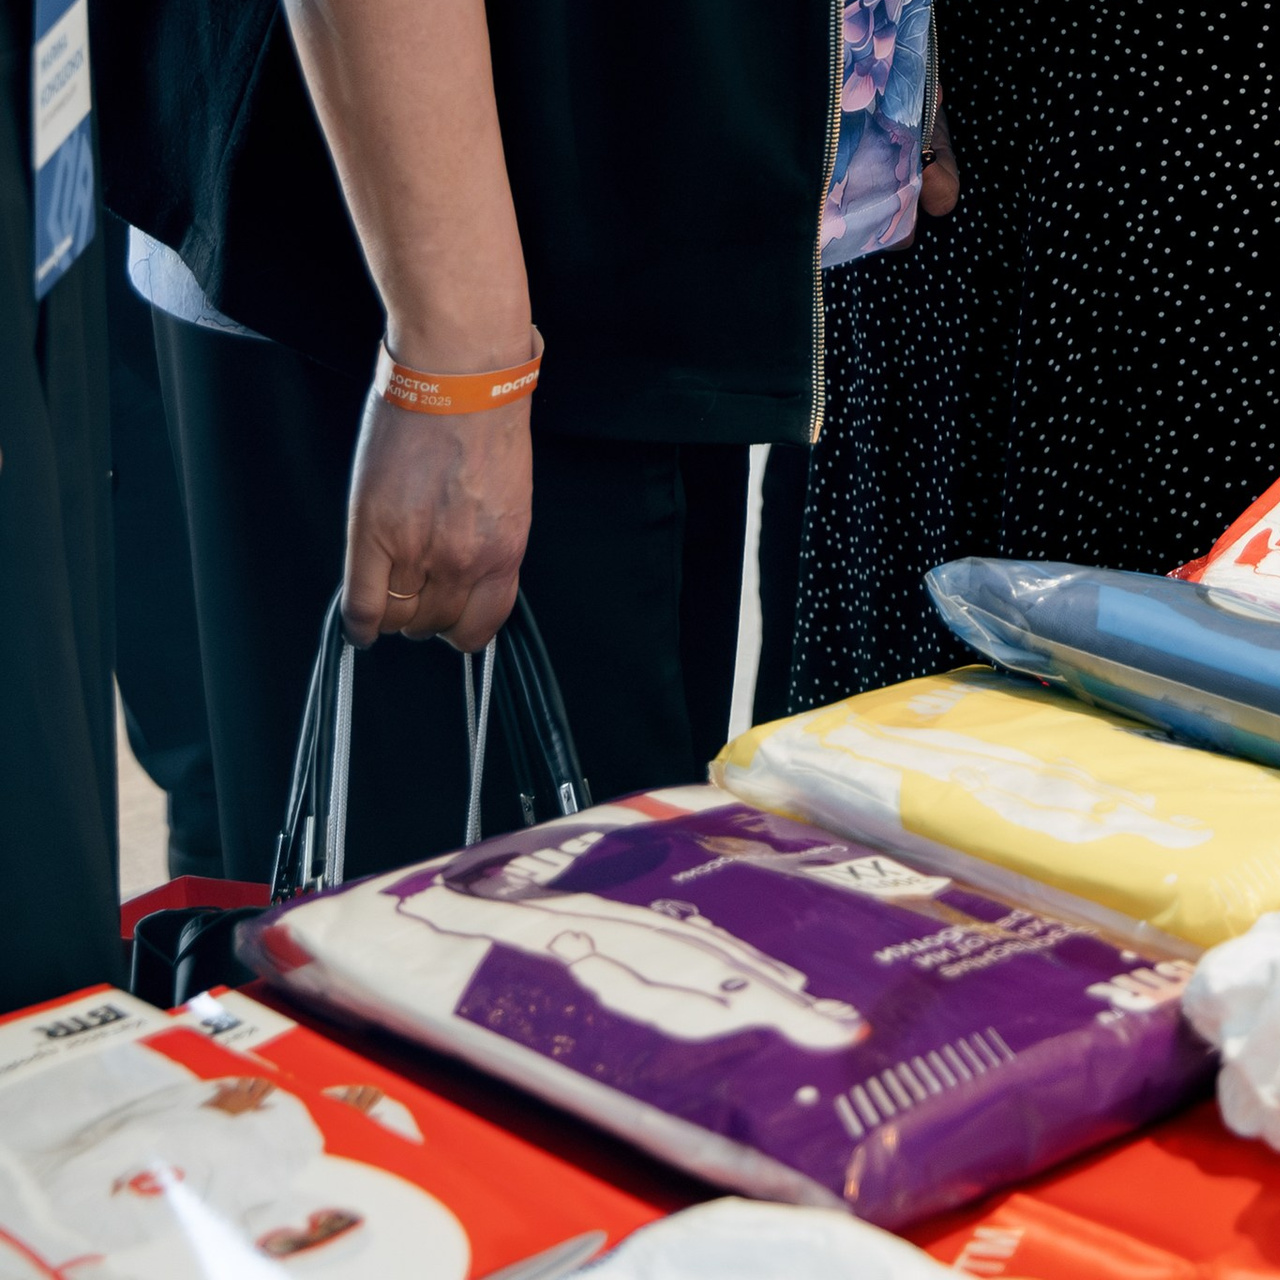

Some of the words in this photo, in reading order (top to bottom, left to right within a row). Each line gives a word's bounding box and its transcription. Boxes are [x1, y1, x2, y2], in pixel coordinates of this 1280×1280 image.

[389, 373, 440, 394] ВОСТОК
[386, 385, 418, 403] КЛУБ
[420, 394, 452, 407] 2025
